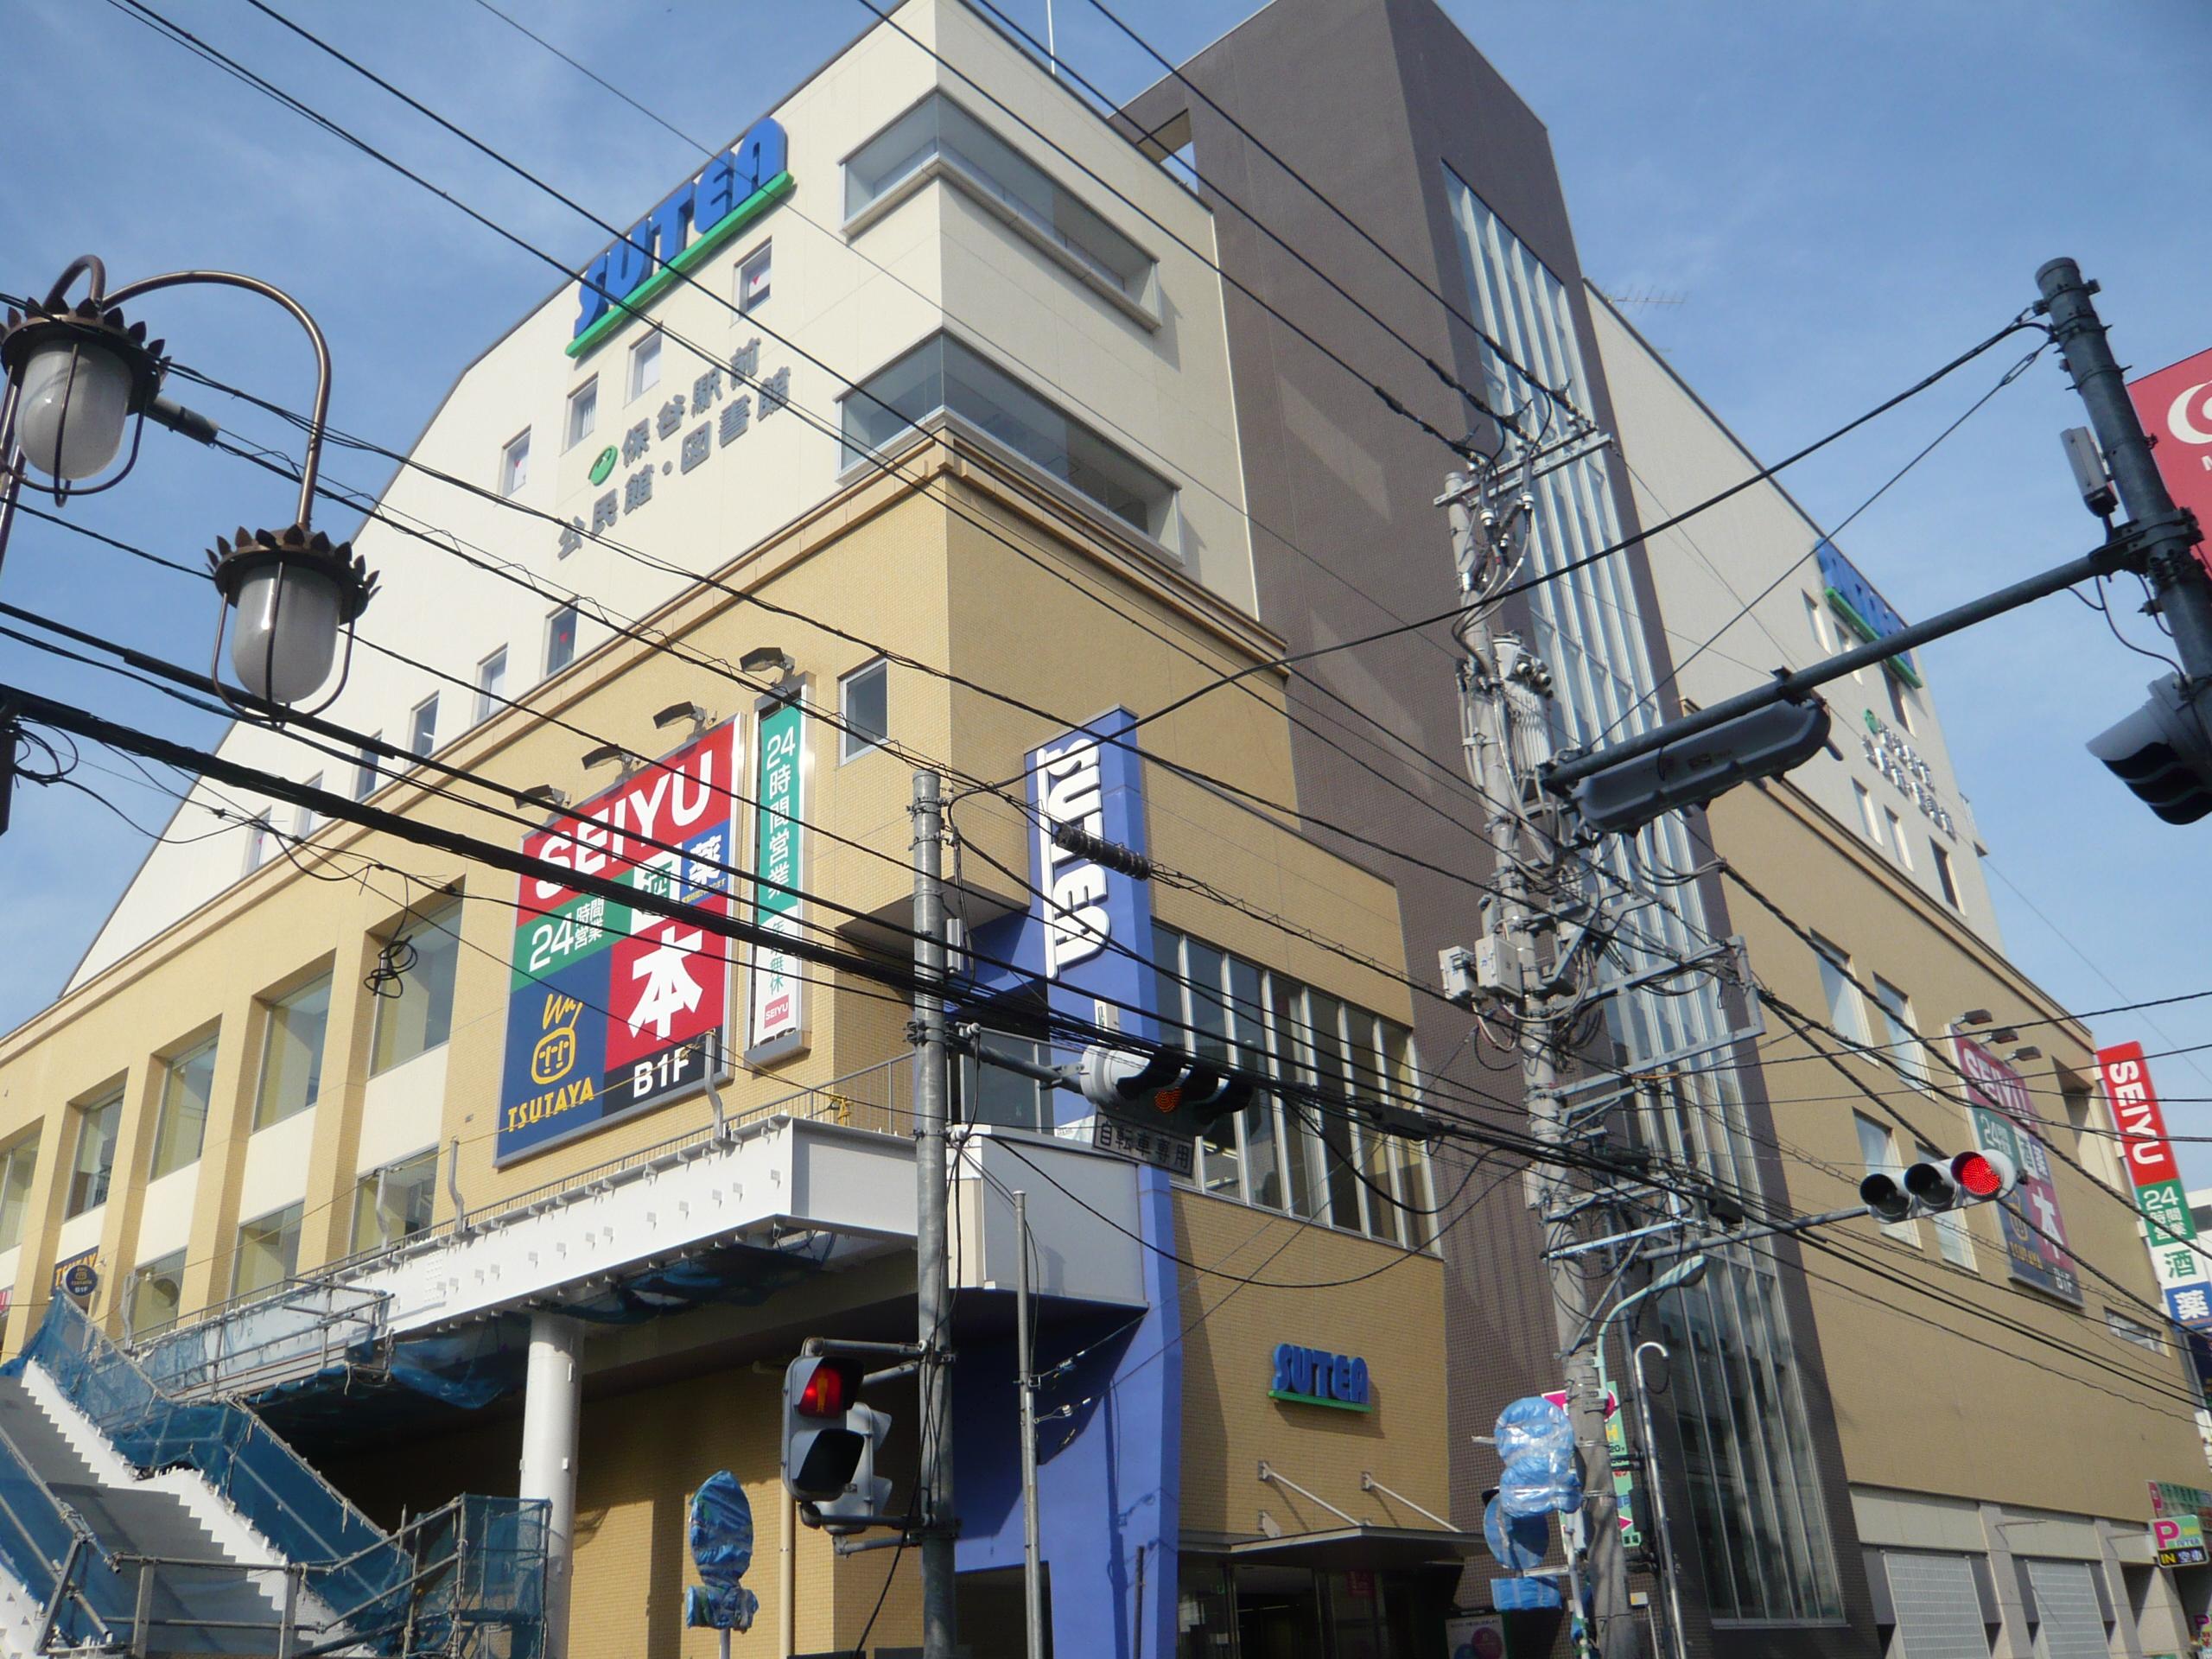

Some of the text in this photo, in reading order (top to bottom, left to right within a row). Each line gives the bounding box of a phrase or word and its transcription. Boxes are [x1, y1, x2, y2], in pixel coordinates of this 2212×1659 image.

[621, 337, 761, 468] 保谷駅前
[535, 750, 713, 899] SEIYU
[766, 726, 796, 899] 24時間営業
[689, 834, 722, 892] 薬
[627, 926, 703, 1040] 本
[769, 920, 785, 995] 年無休
[765, 1001, 789, 1021] SEIYU
[633, 1046, 690, 1098] B1F
[507, 1077, 595, 1133] TSUTAYA
[2108, 1059, 2164, 1165] SEIYU
[1100, 1121, 1190, 1169] 自転車専用
[2143, 1185, 2179, 1211] 24
[2164, 1249, 2197, 1279] 酒
[2173, 1289, 2210, 1320] 薬
[1272, 1343, 1370, 1405] SUTEA
[2152, 1520, 2181, 1550] P
